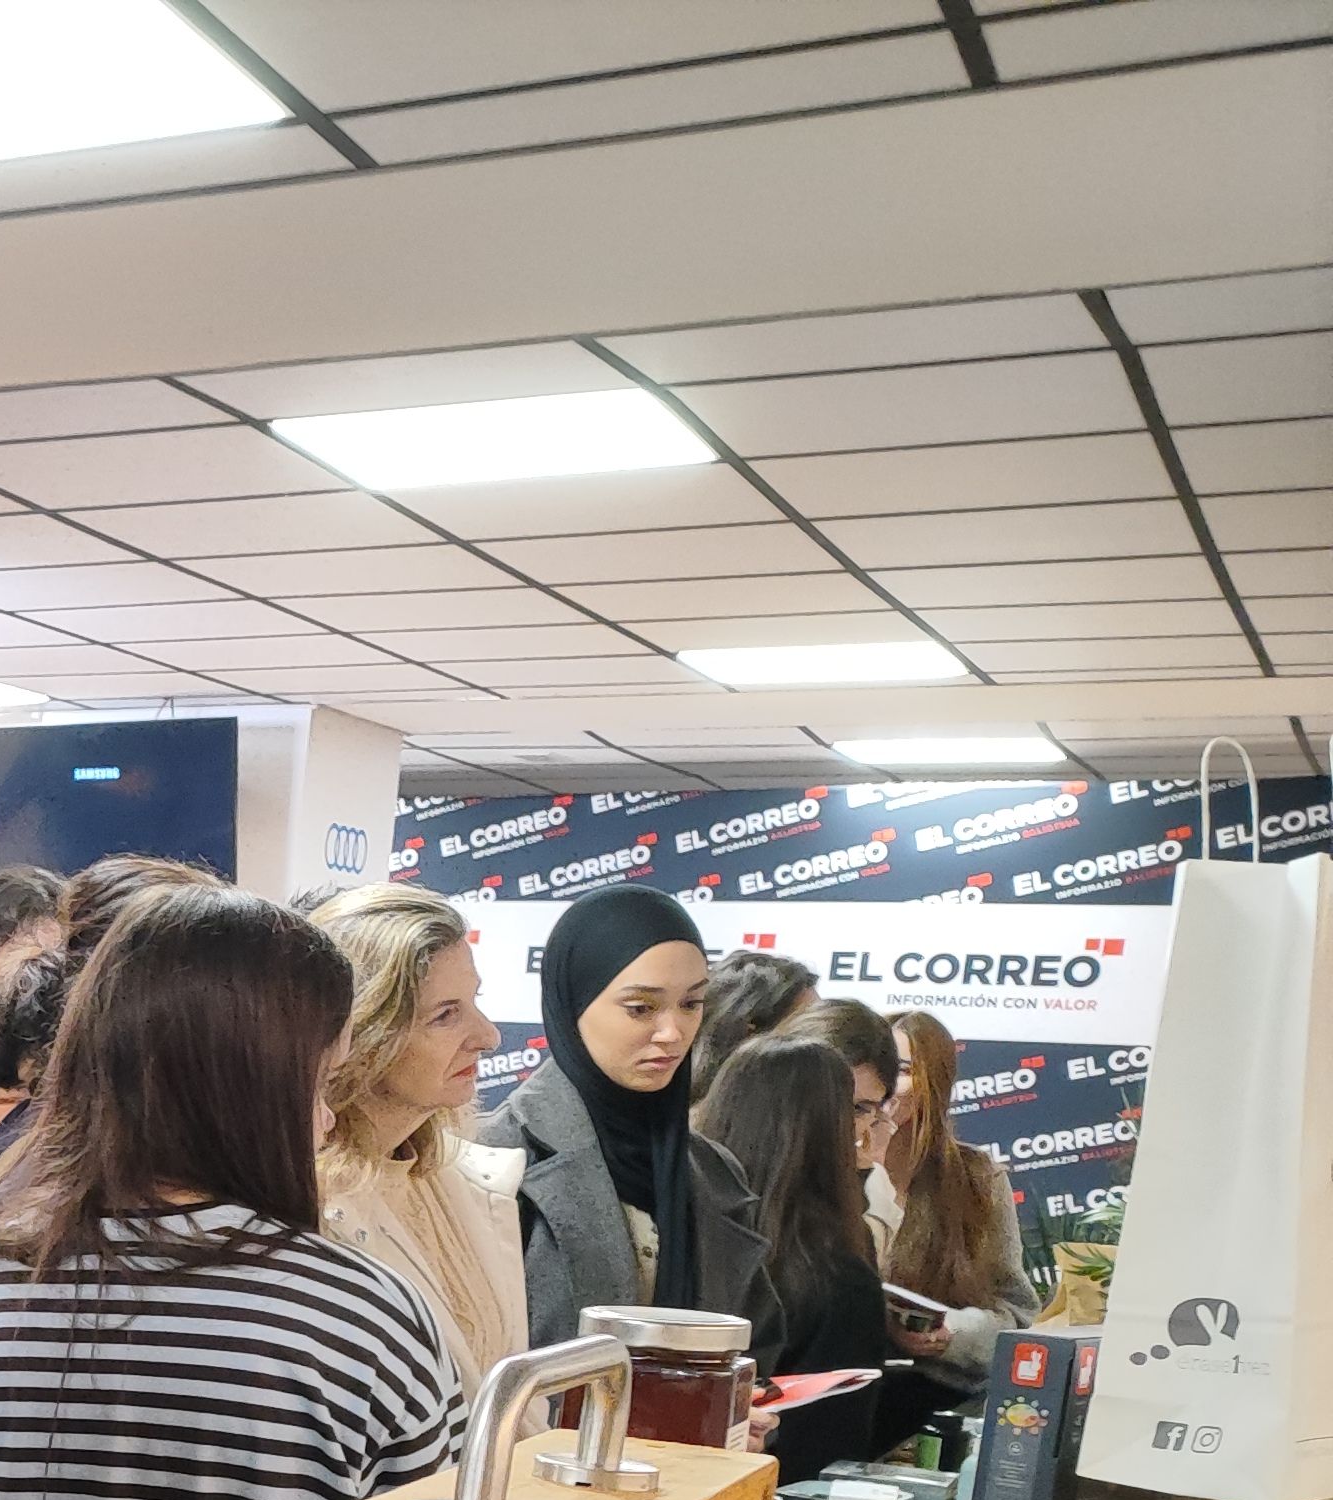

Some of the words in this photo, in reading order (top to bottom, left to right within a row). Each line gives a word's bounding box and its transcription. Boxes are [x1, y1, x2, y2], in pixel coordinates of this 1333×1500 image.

[439, 835, 469, 857] EL
[469, 806, 567, 847] CORREO
[675, 831, 709, 853] EL
[709, 798, 820, 844] CORREO
[1215, 823, 1255, 850] EL
[1259, 800, 1333, 838] COR
[518, 873, 549, 896] EL
[549, 845, 651, 887] CORREO
[739, 871, 773, 895] EL
[774, 840, 888, 886] CORREO
[1013, 870, 1052, 897] EL
[1053, 839, 1183, 887] CORREO
[829, 950, 882, 982] EL
[893, 952, 1101, 988] CORREO
[886, 993, 997, 1010] INFORMACIÓN
[1003, 997, 1038, 1010] CON
[1043, 998, 1097, 1012] VALOR
[478, 1049, 541, 1078] RREO
[1066, 1056, 1106, 1081] EL
[950, 1068, 1037, 1102] RREO
[1012, 1119, 1137, 1160] CORREO
[1046, 1193, 1084, 1217] EL
